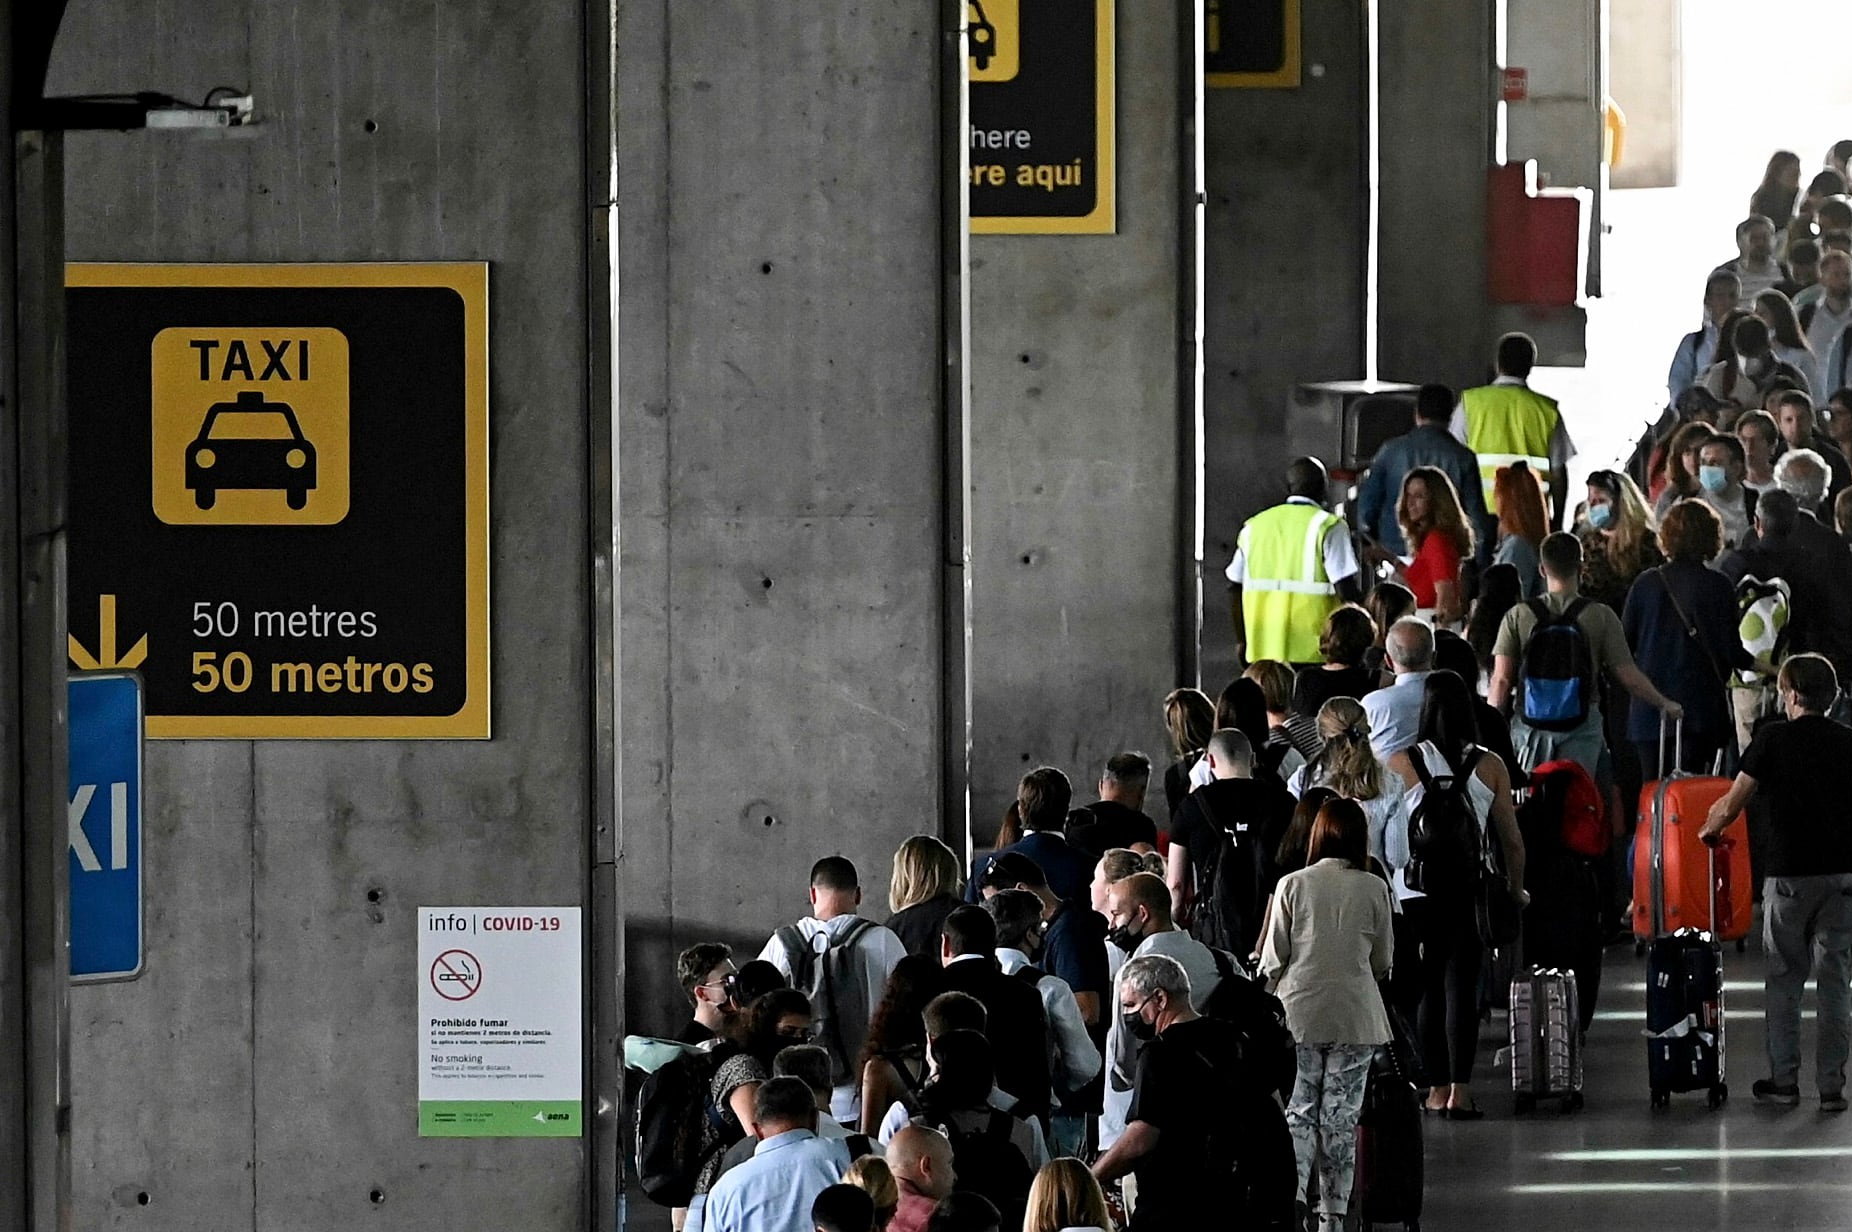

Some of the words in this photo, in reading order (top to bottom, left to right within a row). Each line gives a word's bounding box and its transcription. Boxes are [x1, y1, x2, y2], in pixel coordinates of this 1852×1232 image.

[970, 124, 1031, 149] here
[190, 340, 309, 381] TAXI
[193, 601, 239, 637] 50
[254, 604, 377, 637] metres
[192, 651, 253, 693] 50
[271, 656, 434, 693] metros
[429, 913, 467, 931] info
[483, 917, 560, 931] COVID-19
[431, 1018, 477, 1027] Prohibido
[480, 1018, 508, 1027] fumar
[431, 1054, 443, 1063] No
[446, 1053, 483, 1064] smoking
